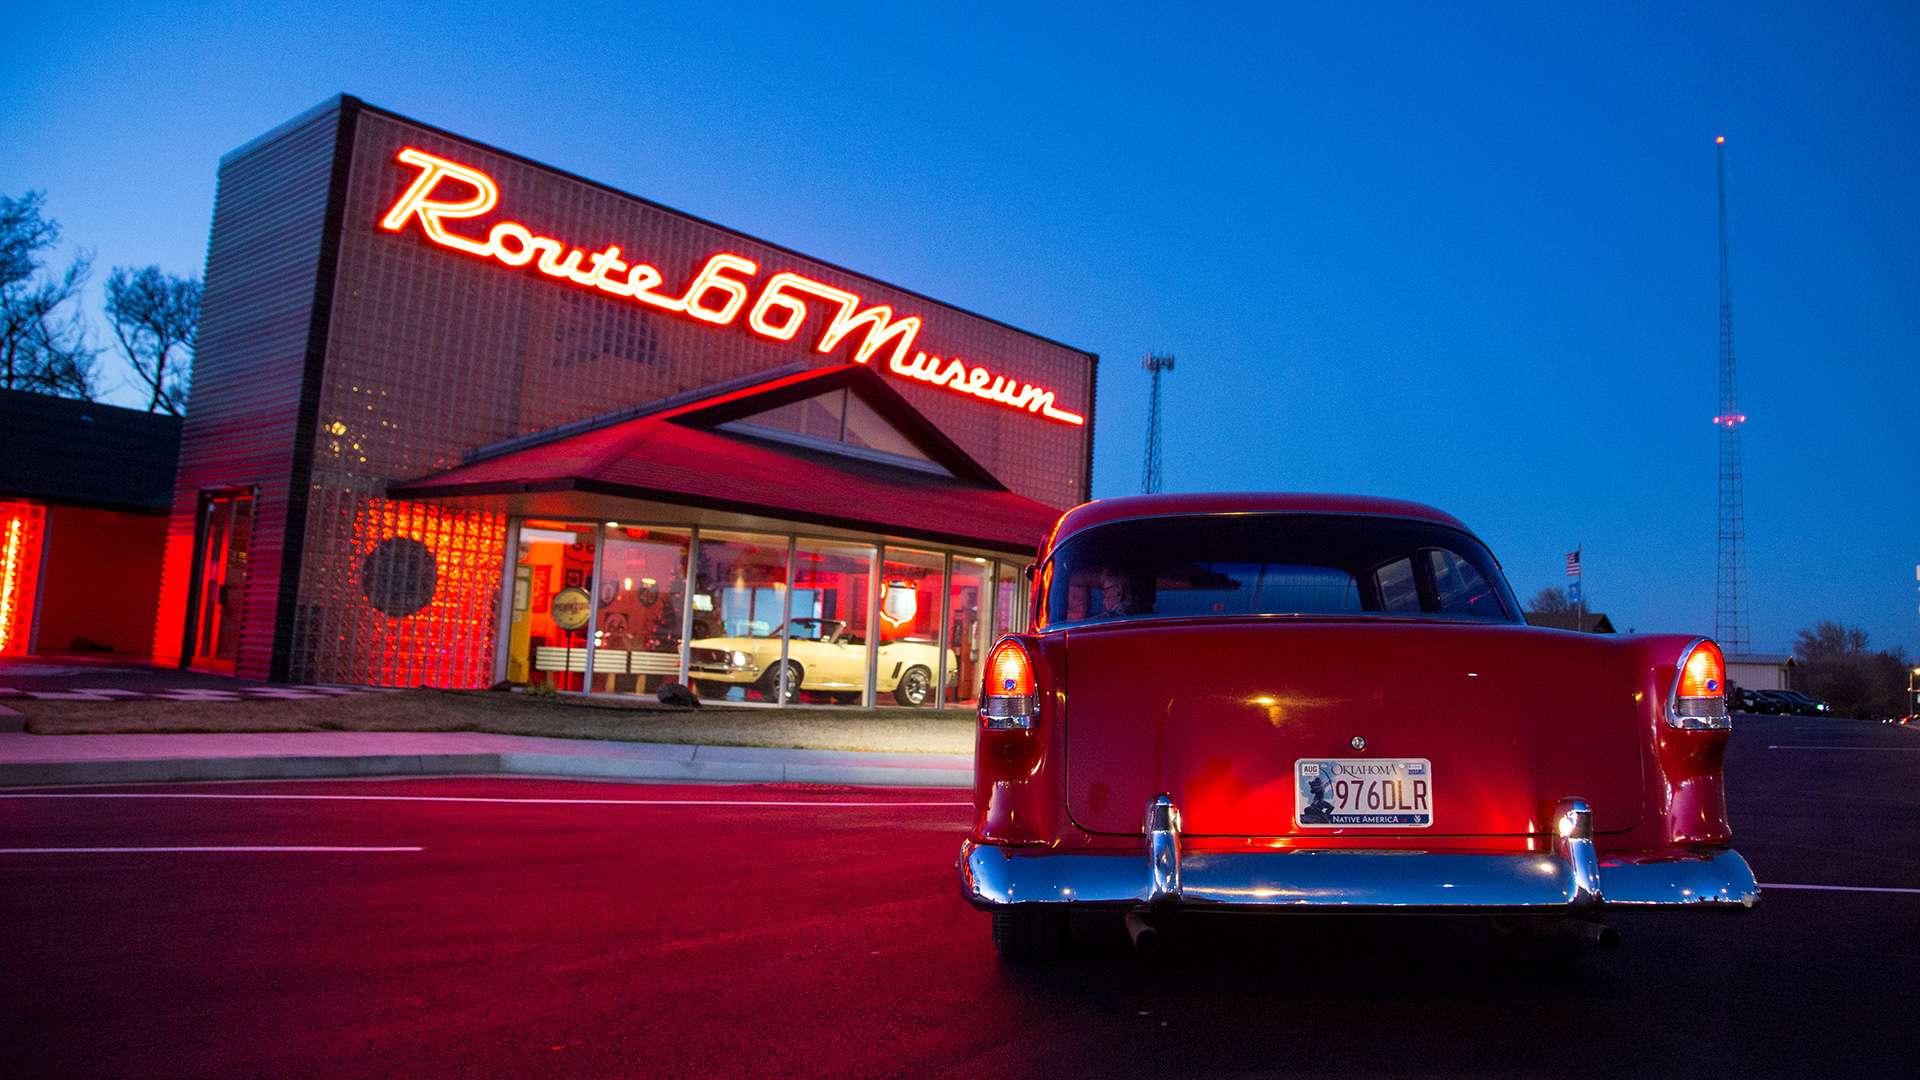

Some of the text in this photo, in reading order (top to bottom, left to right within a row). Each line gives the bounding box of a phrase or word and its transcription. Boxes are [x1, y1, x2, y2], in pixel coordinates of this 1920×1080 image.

[379, 147, 1085, 425] Route 66 Museum
[608, 619, 625, 633] 66
[1303, 765, 1318, 773] AUG
[1331, 763, 1398, 779] OKLAHOMA
[1335, 780, 1428, 810] 976DLR
[1332, 815, 1399, 823] NATIVE AMERICA
